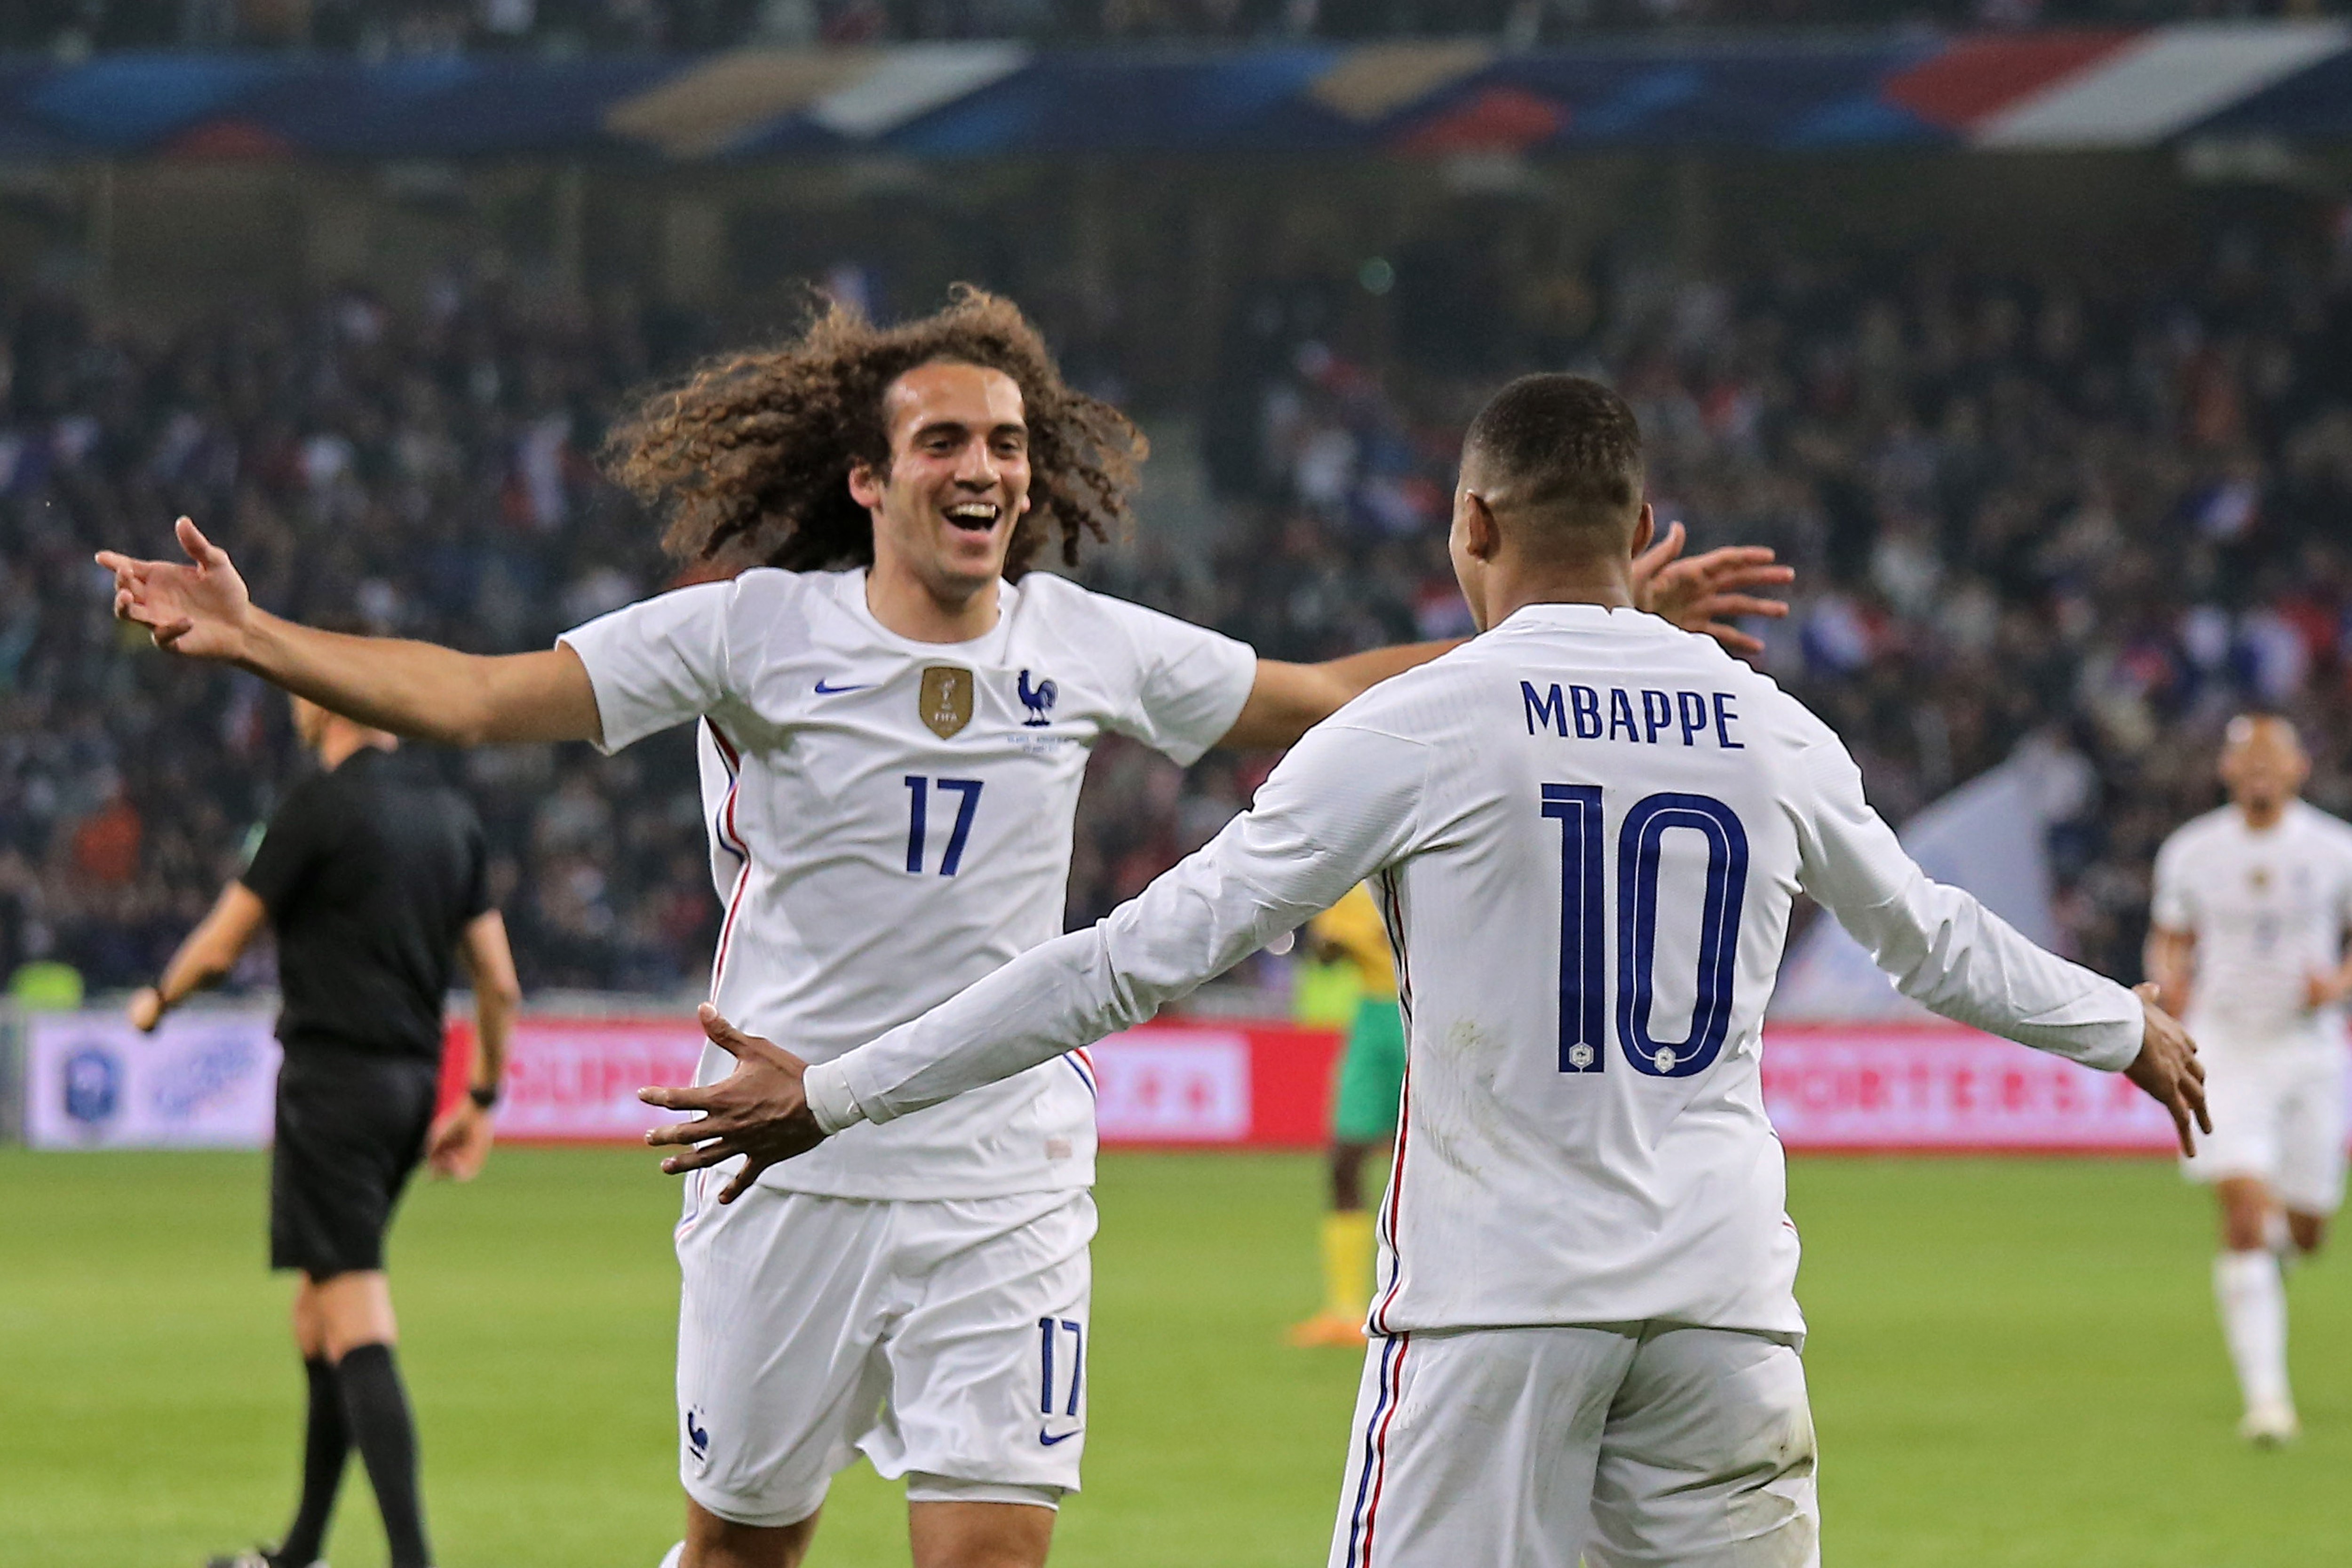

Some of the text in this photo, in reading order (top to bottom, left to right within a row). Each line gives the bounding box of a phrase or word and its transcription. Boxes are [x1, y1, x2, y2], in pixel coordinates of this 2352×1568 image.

[934, 712, 958, 722] FIFA
[1520, 681, 1745, 749] MBAPPE
[905, 776, 984, 876] 17
[1541, 783, 1748, 1077] 10
[1039, 1318, 1080, 1416] 17
